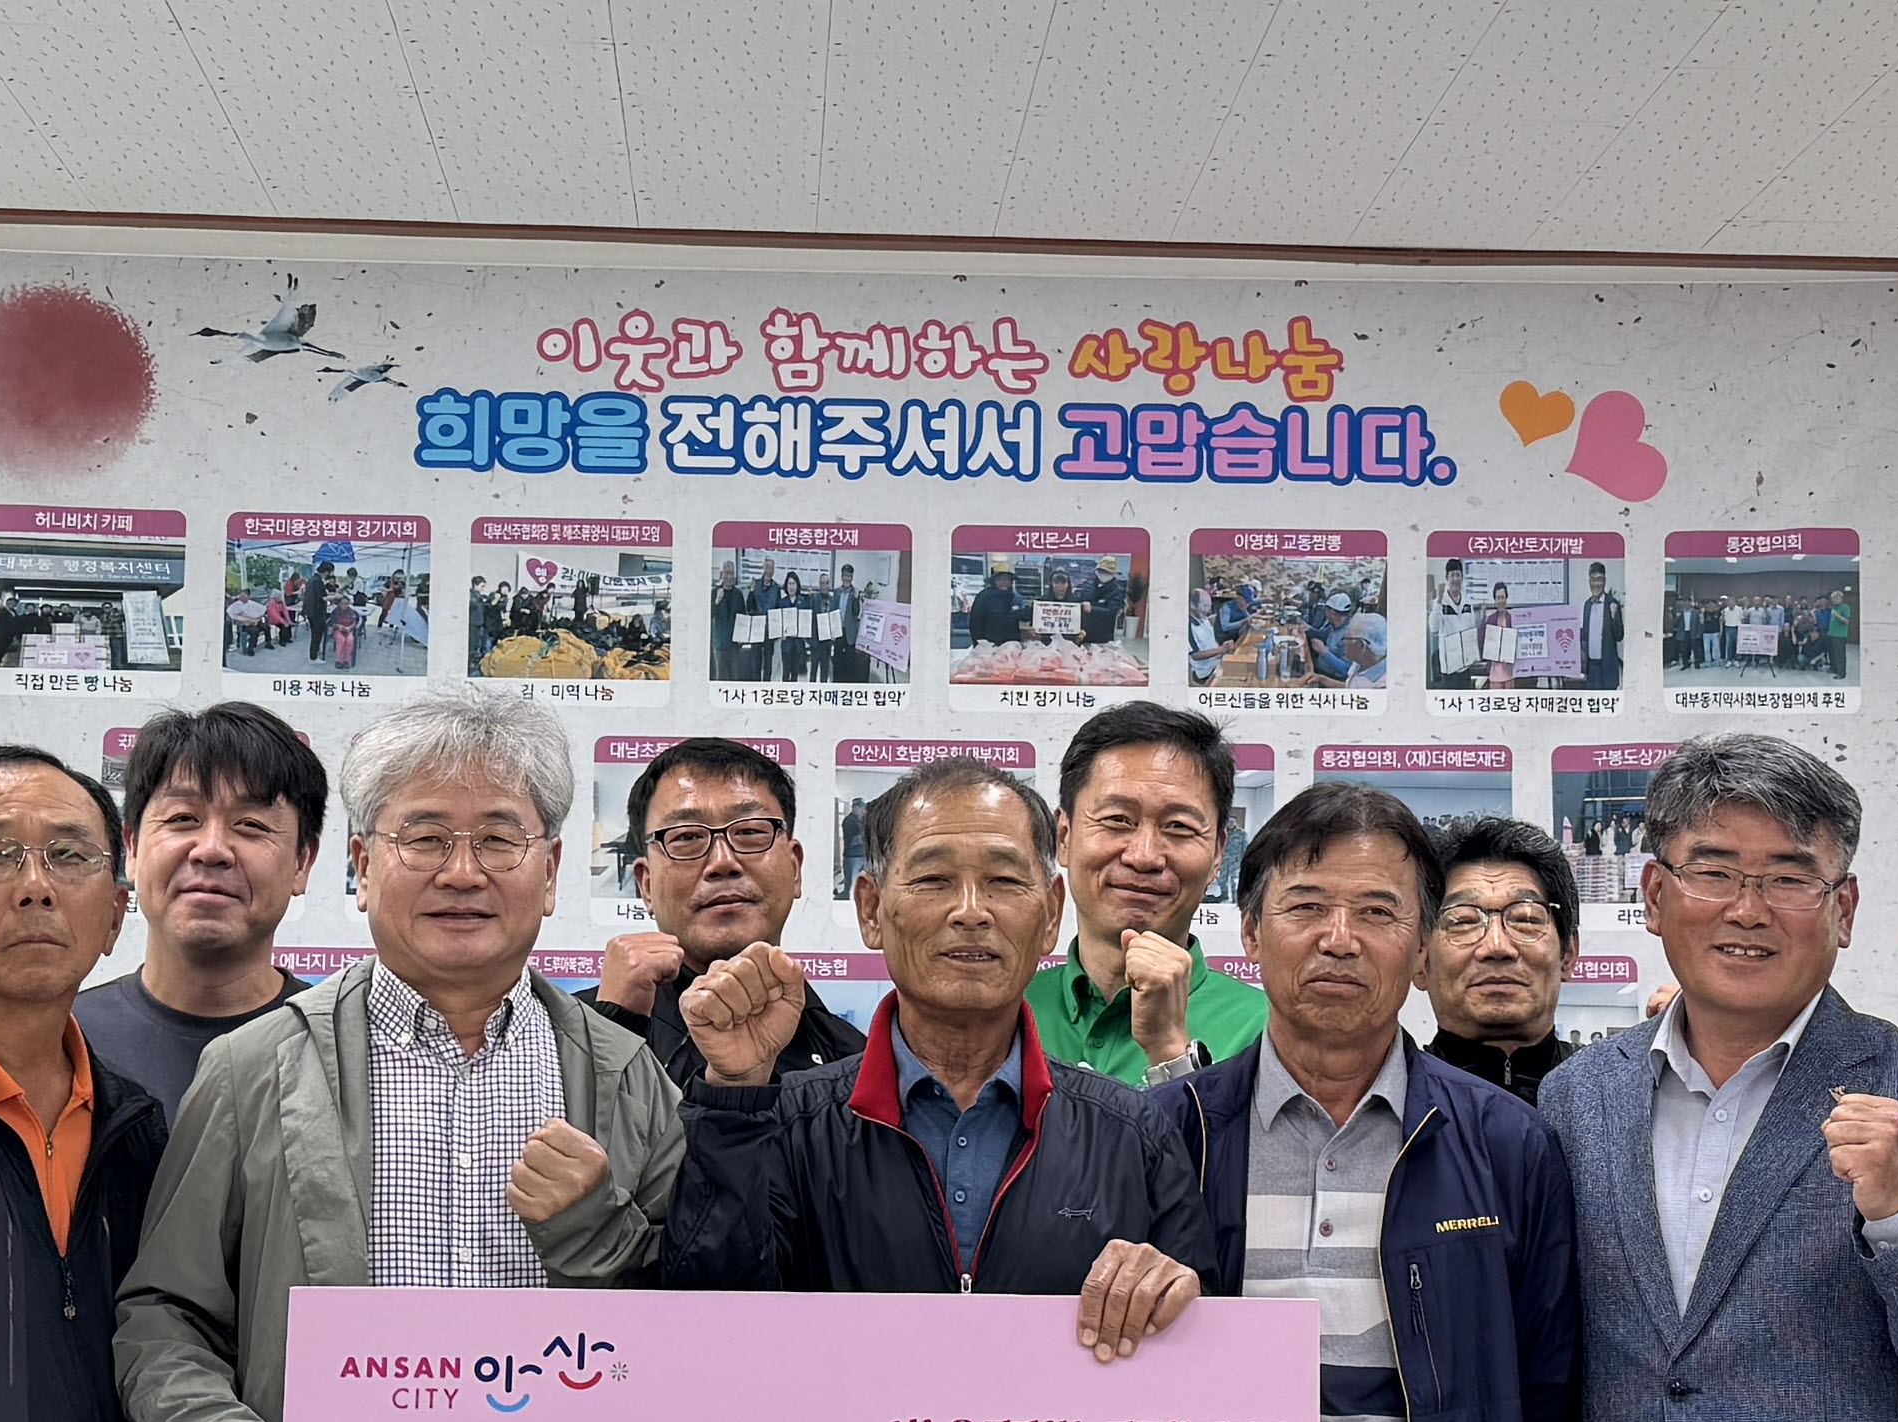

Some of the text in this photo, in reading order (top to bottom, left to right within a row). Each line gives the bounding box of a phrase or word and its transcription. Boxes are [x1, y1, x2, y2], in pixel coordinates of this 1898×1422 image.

[538, 307, 1343, 402] 이웃과 함께하는 사랑나눔
[414, 389, 1457, 486] 희망을 전해주셔서 고맙습니다.
[35, 511, 134, 532] 허니비치 카페
[245, 517, 418, 539] 한국미용장협회 경기지회
[551, 524, 561, 541] 및
[611, 525, 640, 543] 대표자
[768, 528, 859, 546] 대영종합건재
[1015, 531, 1091, 549] 치킨몬스터
[1233, 533, 1342, 552] 이영화 교동짬뽕
[1467, 536, 1585, 555] (주)지산토지개발
[1726, 533, 1803, 554] 통장협의회
[14, 673, 45, 693] 직접
[48, 674, 80, 692] 만든
[102, 675, 133, 693] 나눔
[272, 679, 372, 698] 미용 재능 나눔
[551, 684, 580, 700] 미역
[585, 685, 615, 701] 나눔
[1000, 692, 1029, 707] 치킨
[1066, 692, 1096, 707] 나눔
[1275, 694, 1304, 710] 위한
[1308, 695, 1337, 710] 식사
[1341, 695, 1370, 710] 나눔
[852, 745, 892, 763] 안산시
[279, 952, 326, 971] 에너지
[341, 1357, 460, 1378] ANSAN
[393, 1388, 458, 1409] CITY
